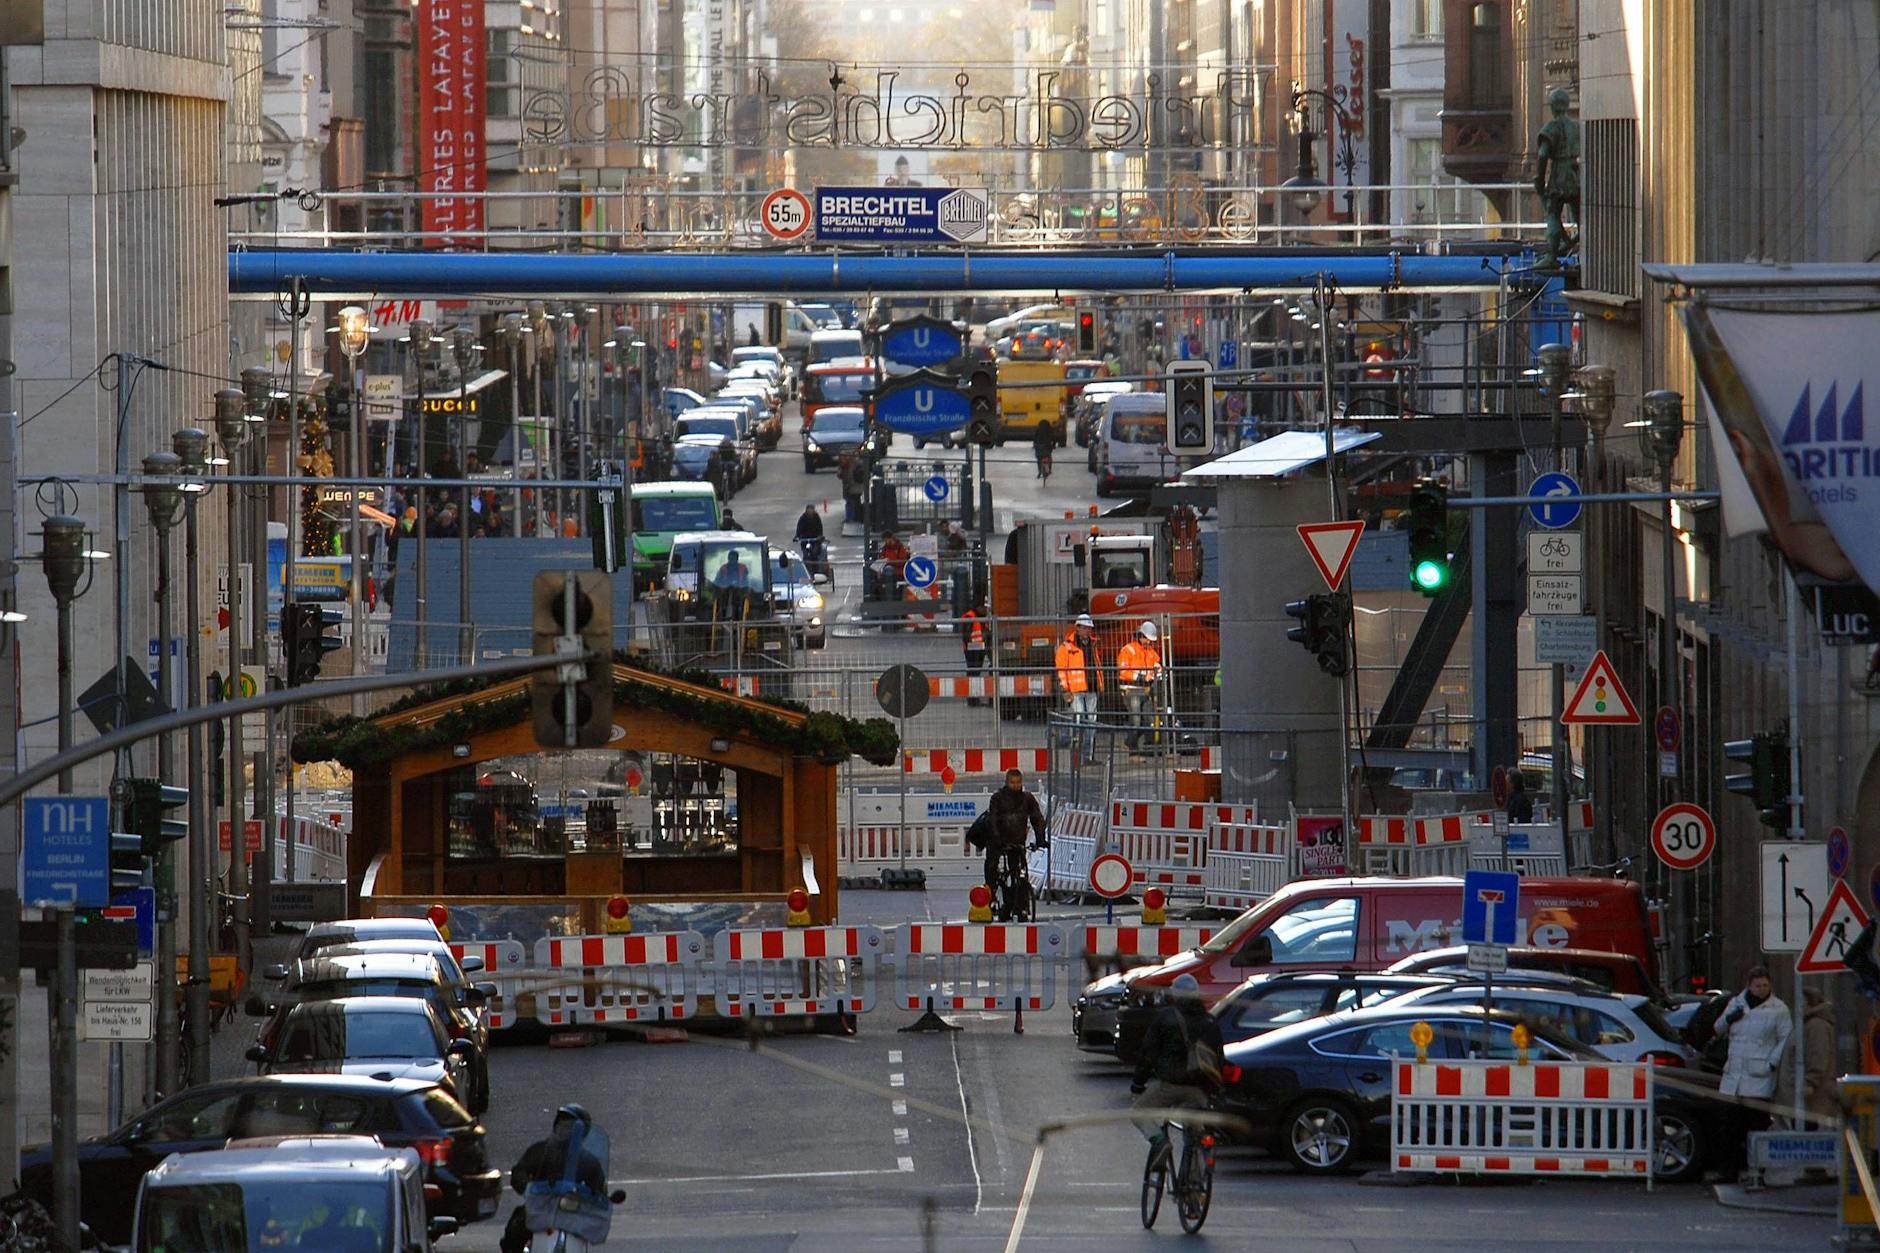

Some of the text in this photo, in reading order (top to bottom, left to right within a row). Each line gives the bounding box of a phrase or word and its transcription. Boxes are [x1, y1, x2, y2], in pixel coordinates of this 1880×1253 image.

[432, 0, 453, 112] LAFAYE
[821, 196, 934, 215] BRECHTEL
[821, 215, 906, 227] SPEZIALTIEFBAU
[913, 328, 930, 348] U
[915, 390, 933, 412] U
[885, 414, 965, 422] Französische Straße
[1547, 559, 1564, 568] frei
[1536, 580, 1574, 588] Einsatz-
[1533, 591, 1577, 600] fahrzeuge
[1547, 602, 1563, 611] frei
[43, 835, 92, 845] HOTELES
[1666, 822, 1701, 851] 30
[47, 854, 85, 864] BERLIN
[1532, 898, 1600, 908] www.miele.de
[104, 987, 130, 995] für LKW
[96, 1004, 138, 1014] Lieferverkehr
[110, 1028, 122, 1037] frei
[1768, 1139, 1835, 1151] NIEMEIER
